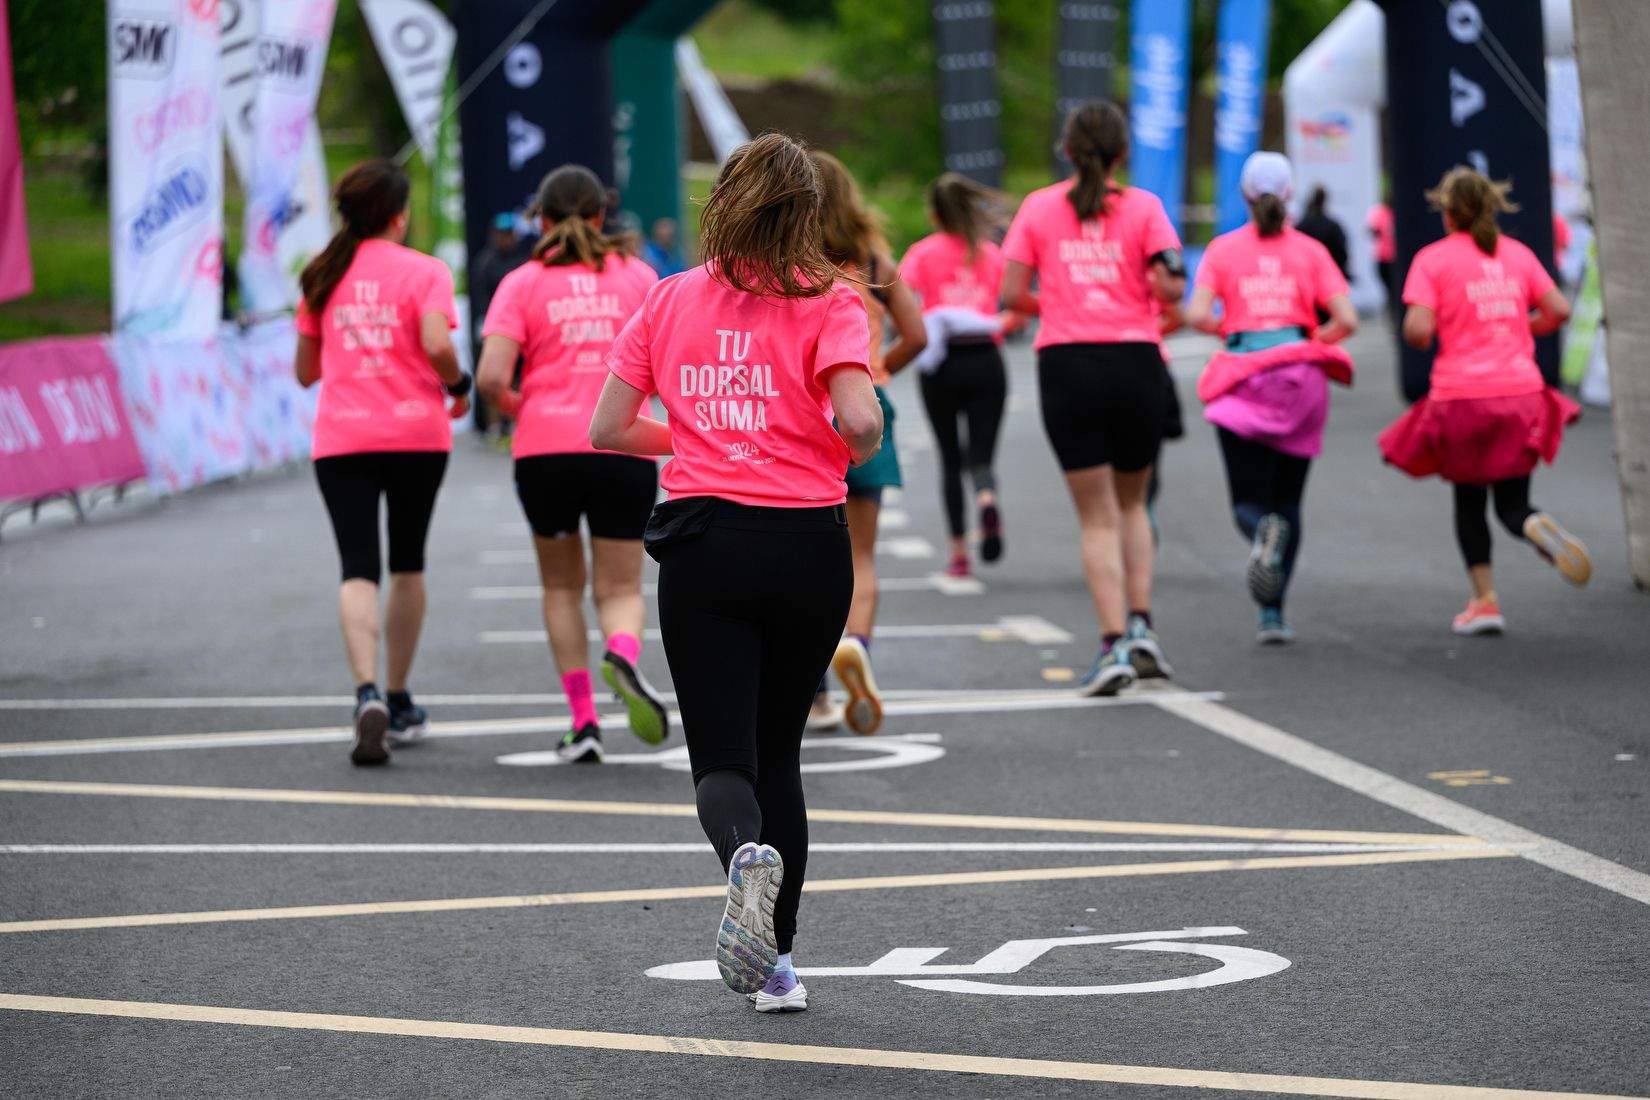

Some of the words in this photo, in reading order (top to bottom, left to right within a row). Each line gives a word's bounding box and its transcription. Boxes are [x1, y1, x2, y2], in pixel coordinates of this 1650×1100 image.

[353, 280, 380, 303] TU
[568, 273, 598, 295] TU
[547, 294, 624, 324] DORSAL
[560, 319, 615, 345] SUMA
[715, 329, 752, 361] TU
[680, 364, 780, 397] DORSAL
[694, 400, 768, 432] SUMA
